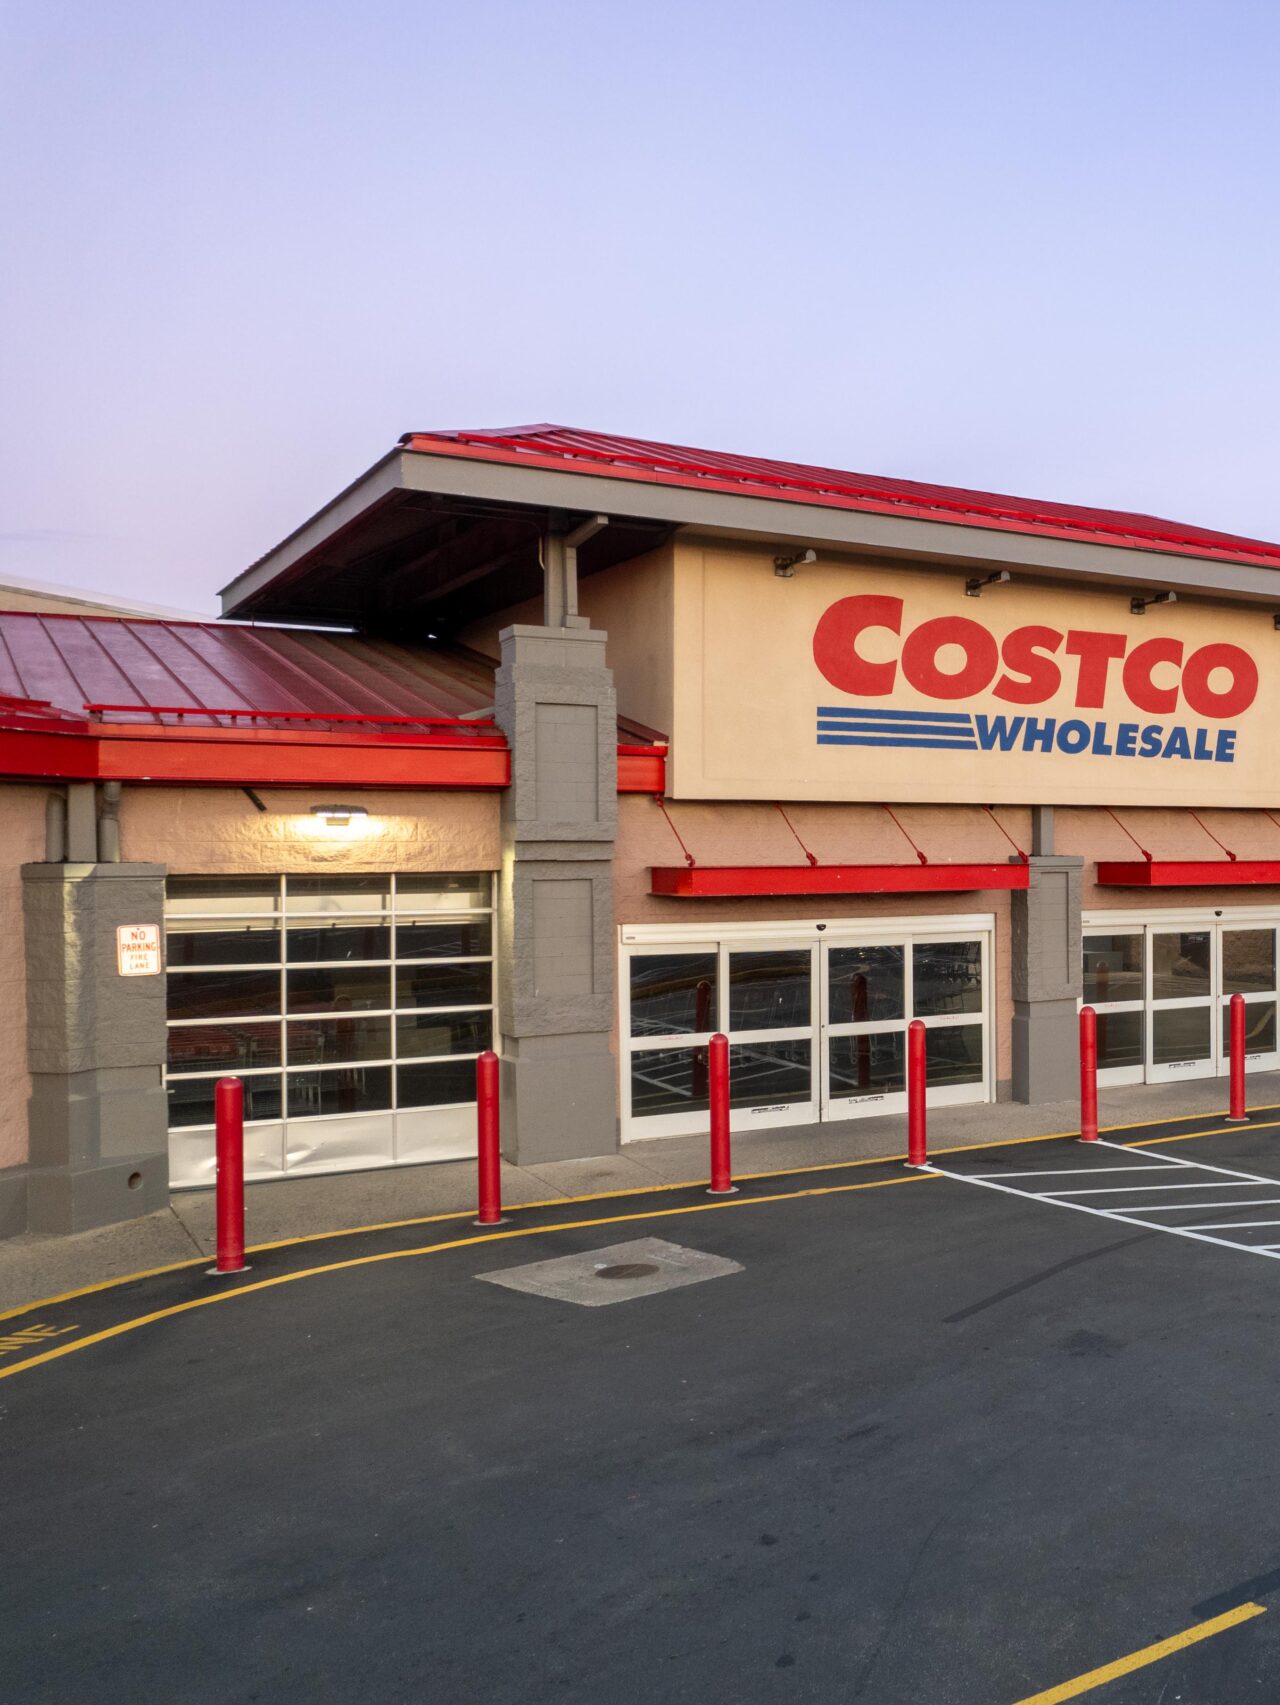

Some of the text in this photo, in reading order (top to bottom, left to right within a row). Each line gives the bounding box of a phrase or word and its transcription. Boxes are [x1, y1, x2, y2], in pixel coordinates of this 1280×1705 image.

[812, 594, 1259, 719] COSTCO
[974, 714, 1236, 763] WHOLESALE
[121, 942, 156, 952] PARKING
[131, 931, 146, 941] NO
